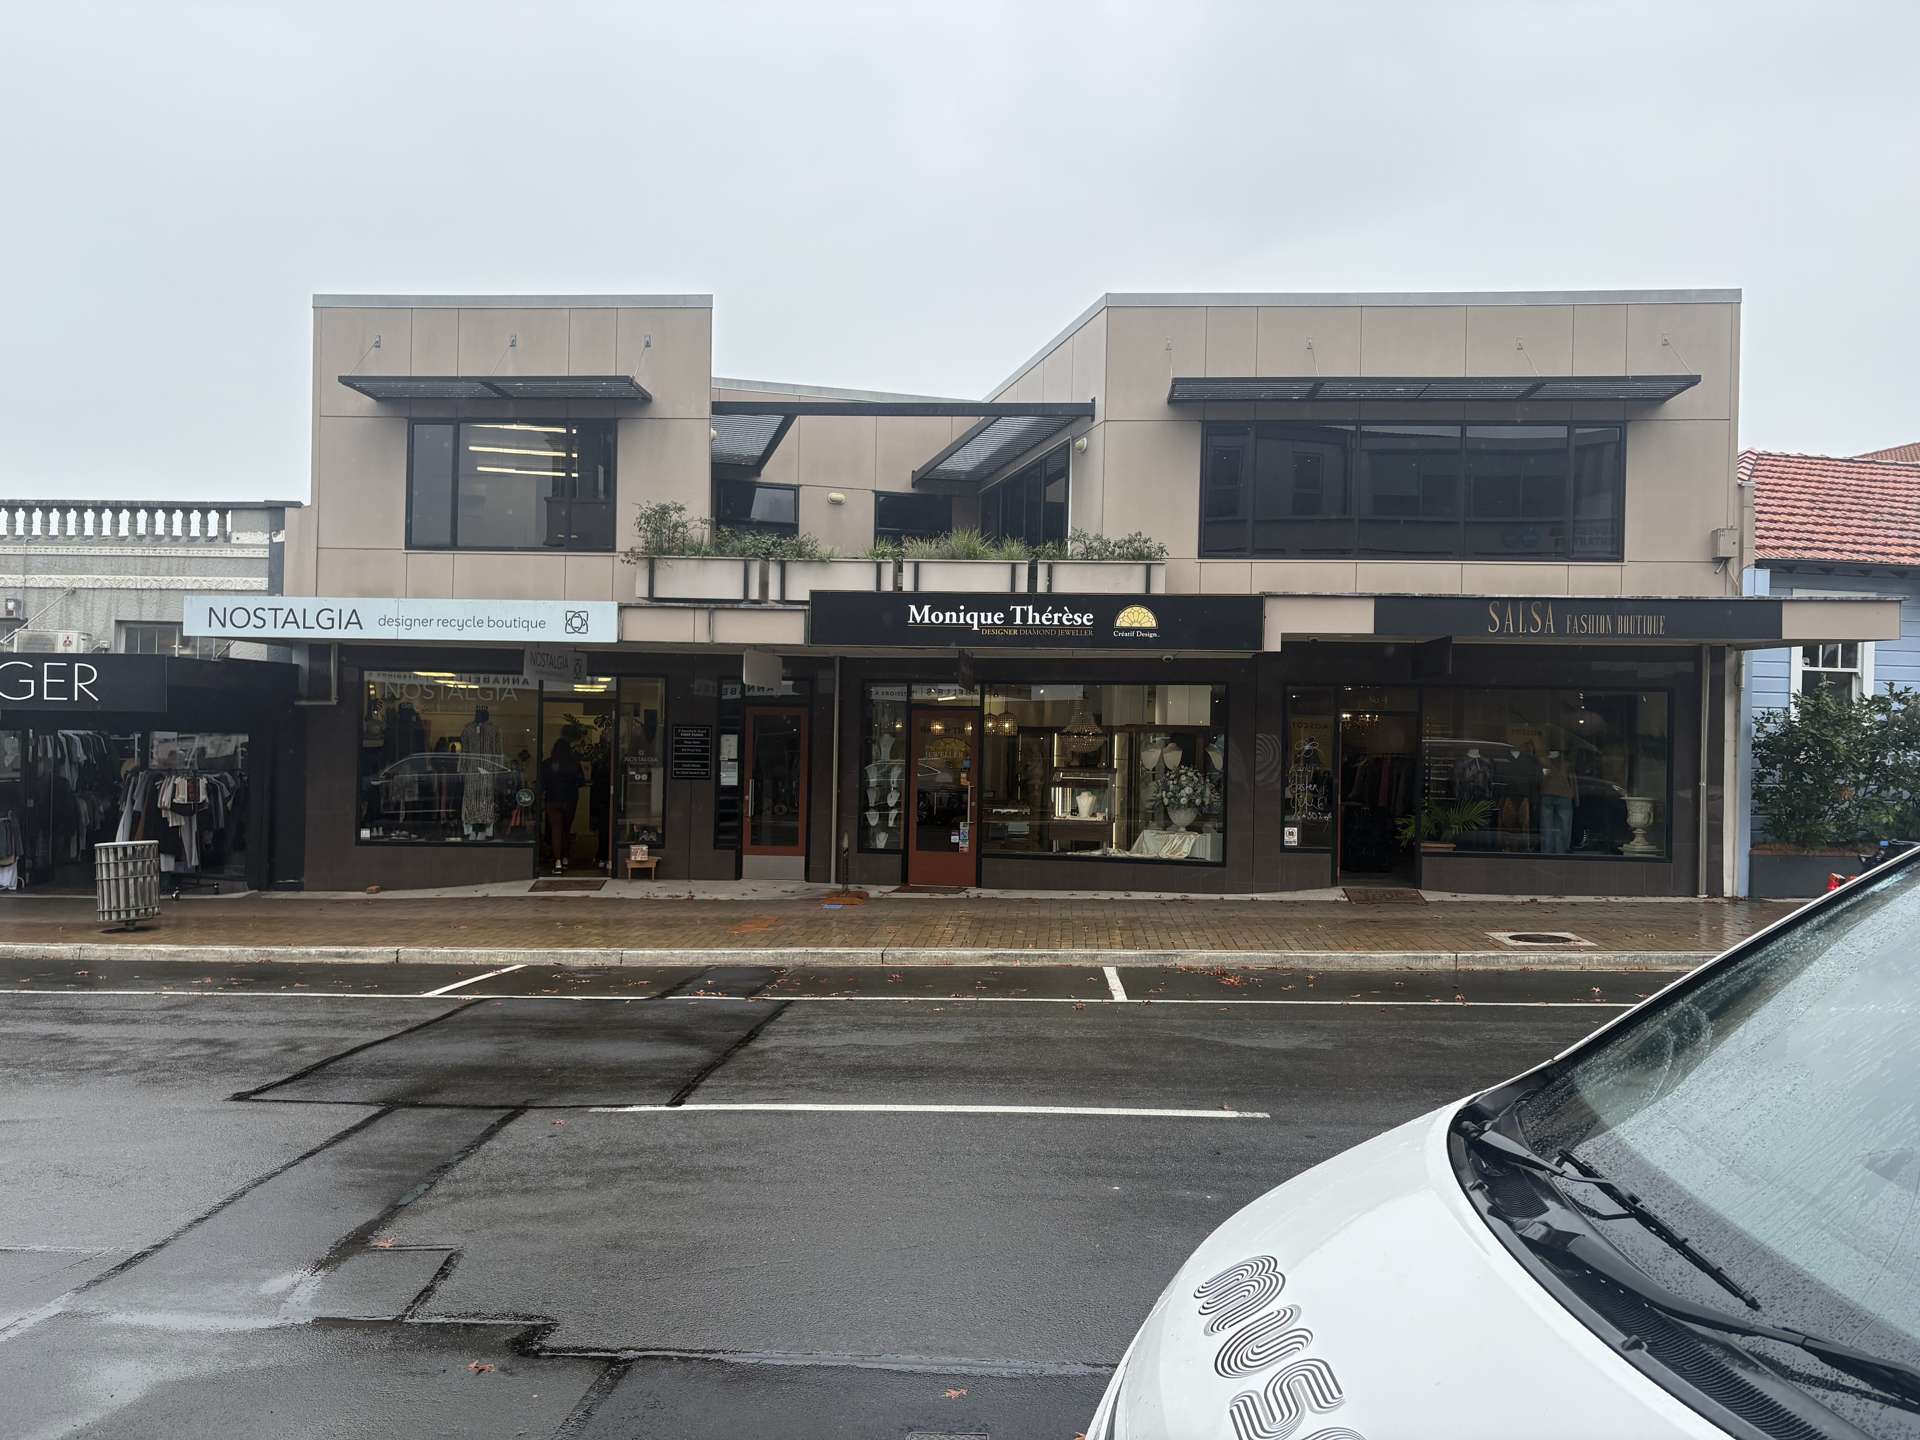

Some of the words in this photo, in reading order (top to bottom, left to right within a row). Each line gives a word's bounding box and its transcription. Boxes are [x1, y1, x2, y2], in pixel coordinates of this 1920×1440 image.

[207, 606, 364, 631] NOSTALGIA
[378, 614, 434, 629] designer
[436, 617, 485, 630] recycle
[487, 616, 546, 630] boutique
[907, 604, 1005, 631] Monique
[1009, 604, 1094, 626] Thérèse
[1487, 600, 1555, 633] SALSA
[1566, 614, 1613, 634] FASHION
[1618, 615, 1666, 636] BOUTIQUE
[981, 628, 1018, 636] DESIGNER
[1113, 630, 1136, 638] Créatif
[529, 650, 569, 670] NOSTALGIA
[0, 661, 100, 702] GER
[384, 682, 519, 701] NOSTALGIA
